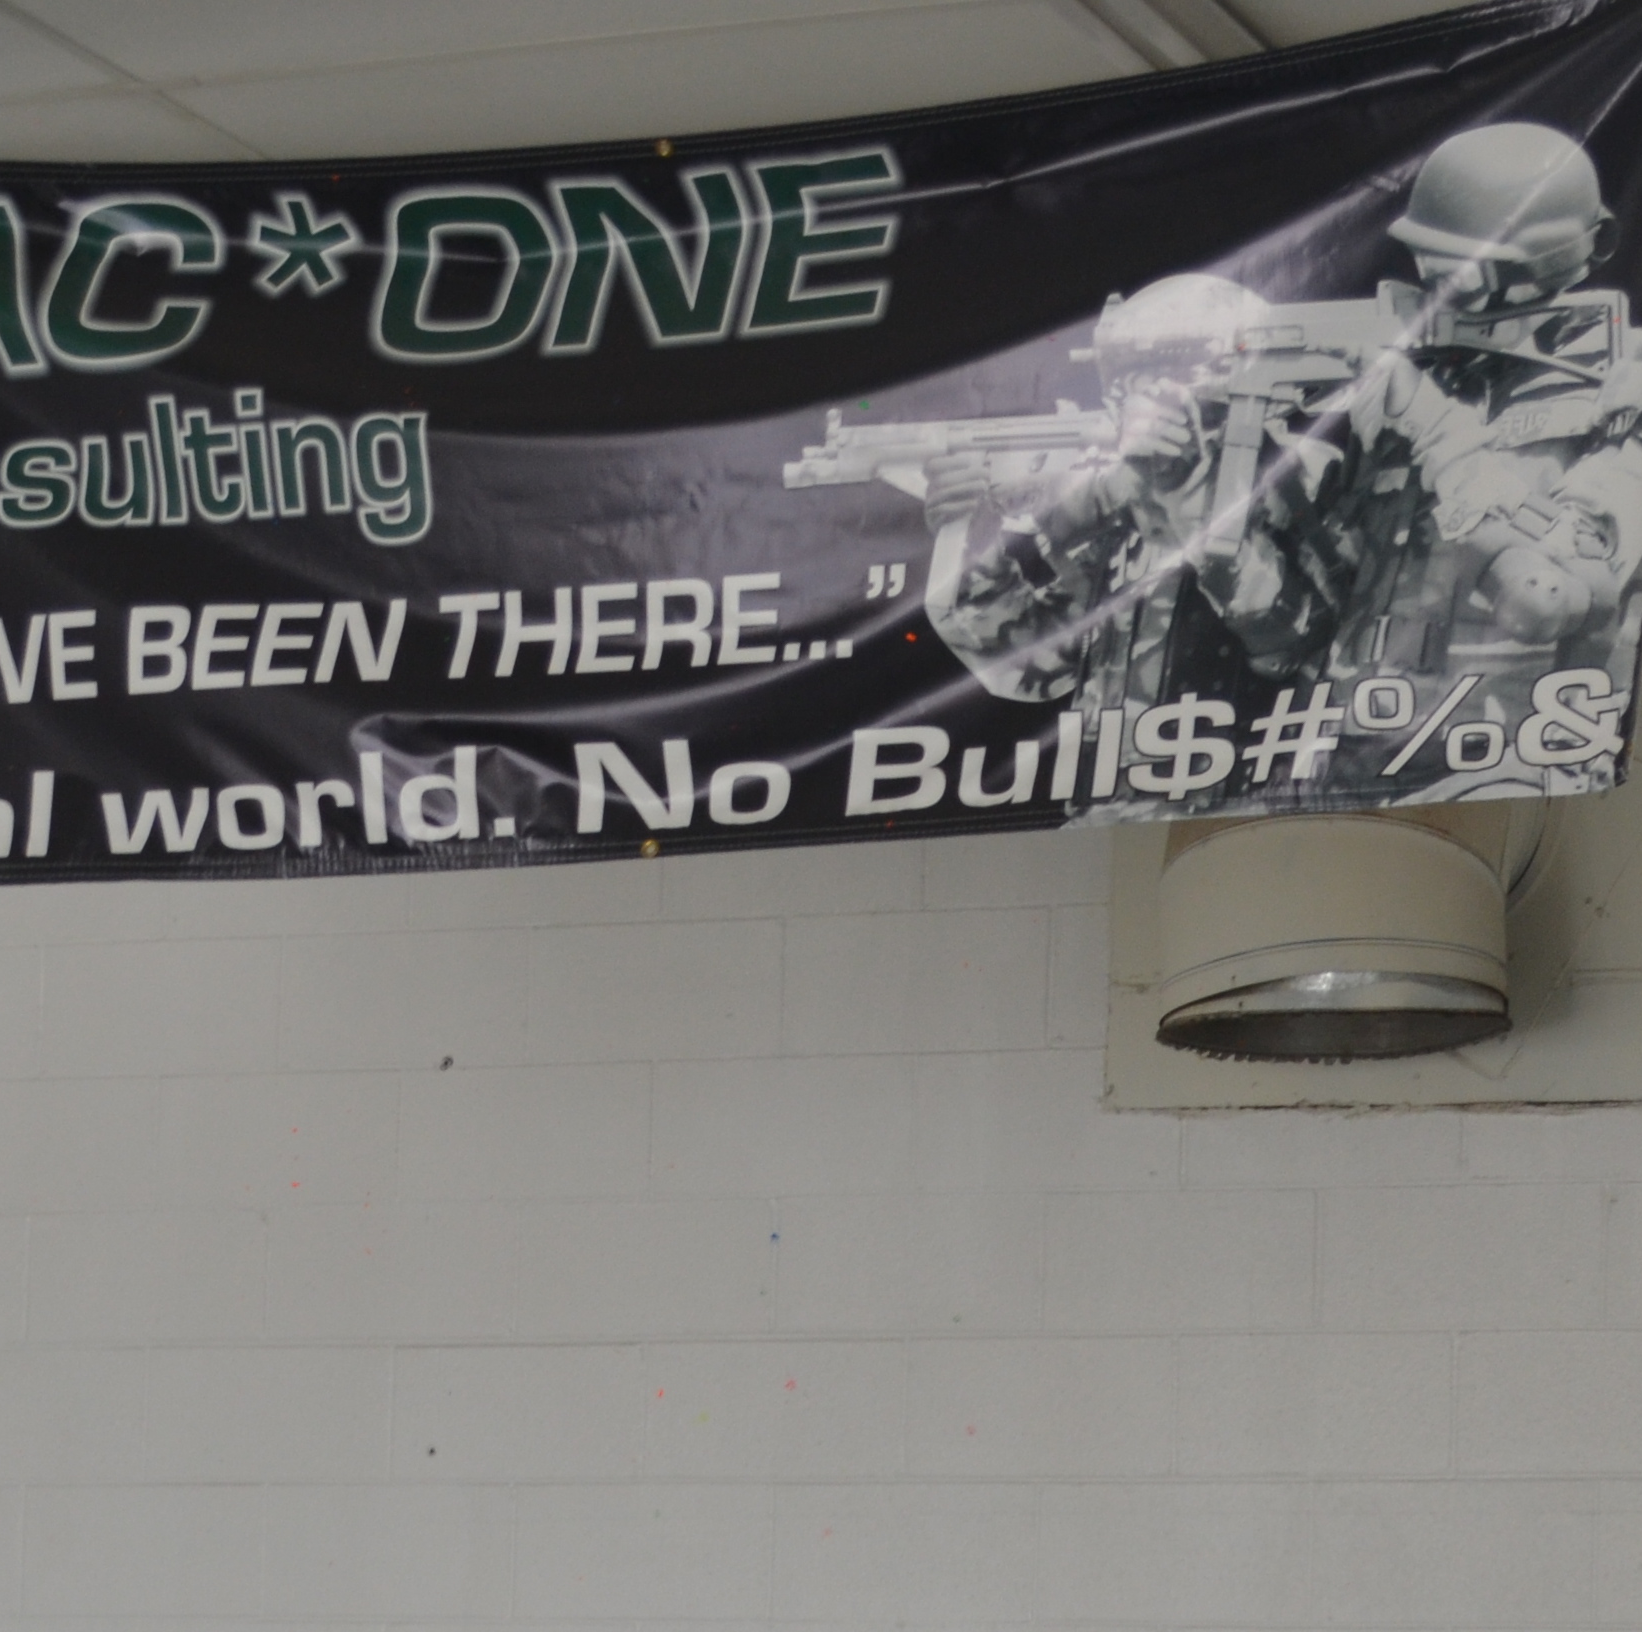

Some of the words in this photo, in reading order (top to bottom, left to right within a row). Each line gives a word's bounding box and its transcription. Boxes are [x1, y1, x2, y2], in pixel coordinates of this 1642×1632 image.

[128, 599, 407, 694] BEEN
[100, 746, 517, 858] world.
[573, 739, 792, 836] No
[844, 667, 1624, 817] Bull$#%&
